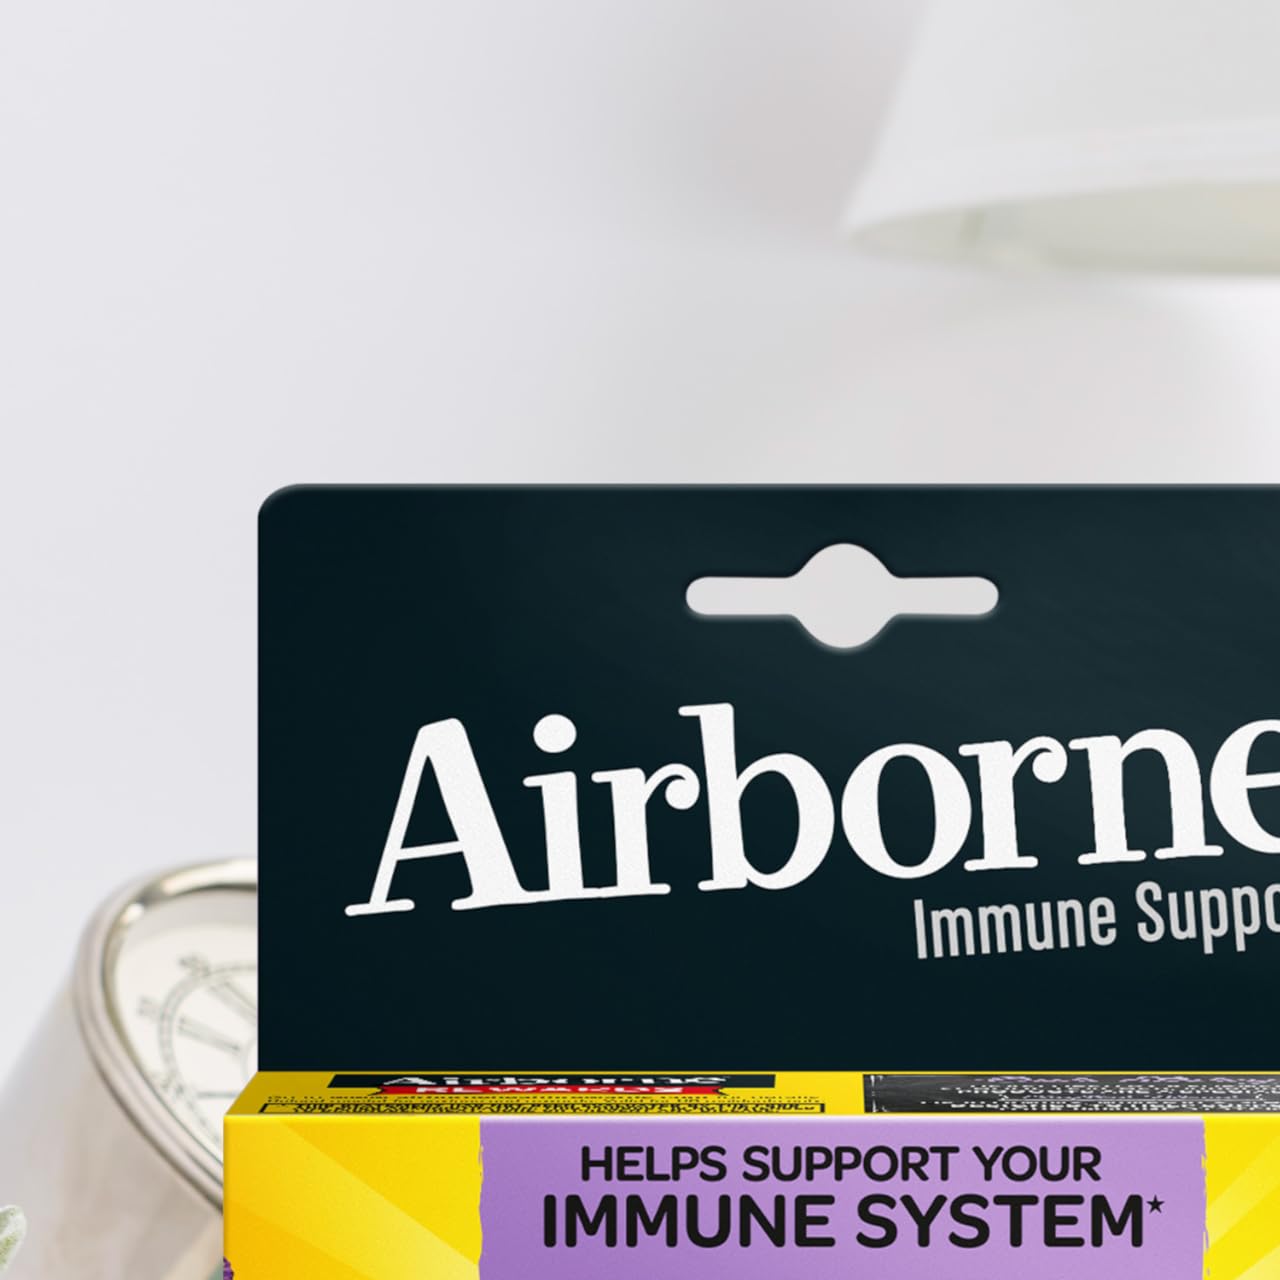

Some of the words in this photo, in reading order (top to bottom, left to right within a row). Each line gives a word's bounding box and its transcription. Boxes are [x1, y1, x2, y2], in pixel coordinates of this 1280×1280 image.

[912, 887, 1118, 960] Immune
[581, 1144, 728, 1182] HELPS
[741, 1144, 960, 1182] SUPPORT
[972, 1144, 1102, 1182] YOUR
[543, 1194, 837, 1249] IMMUNE
